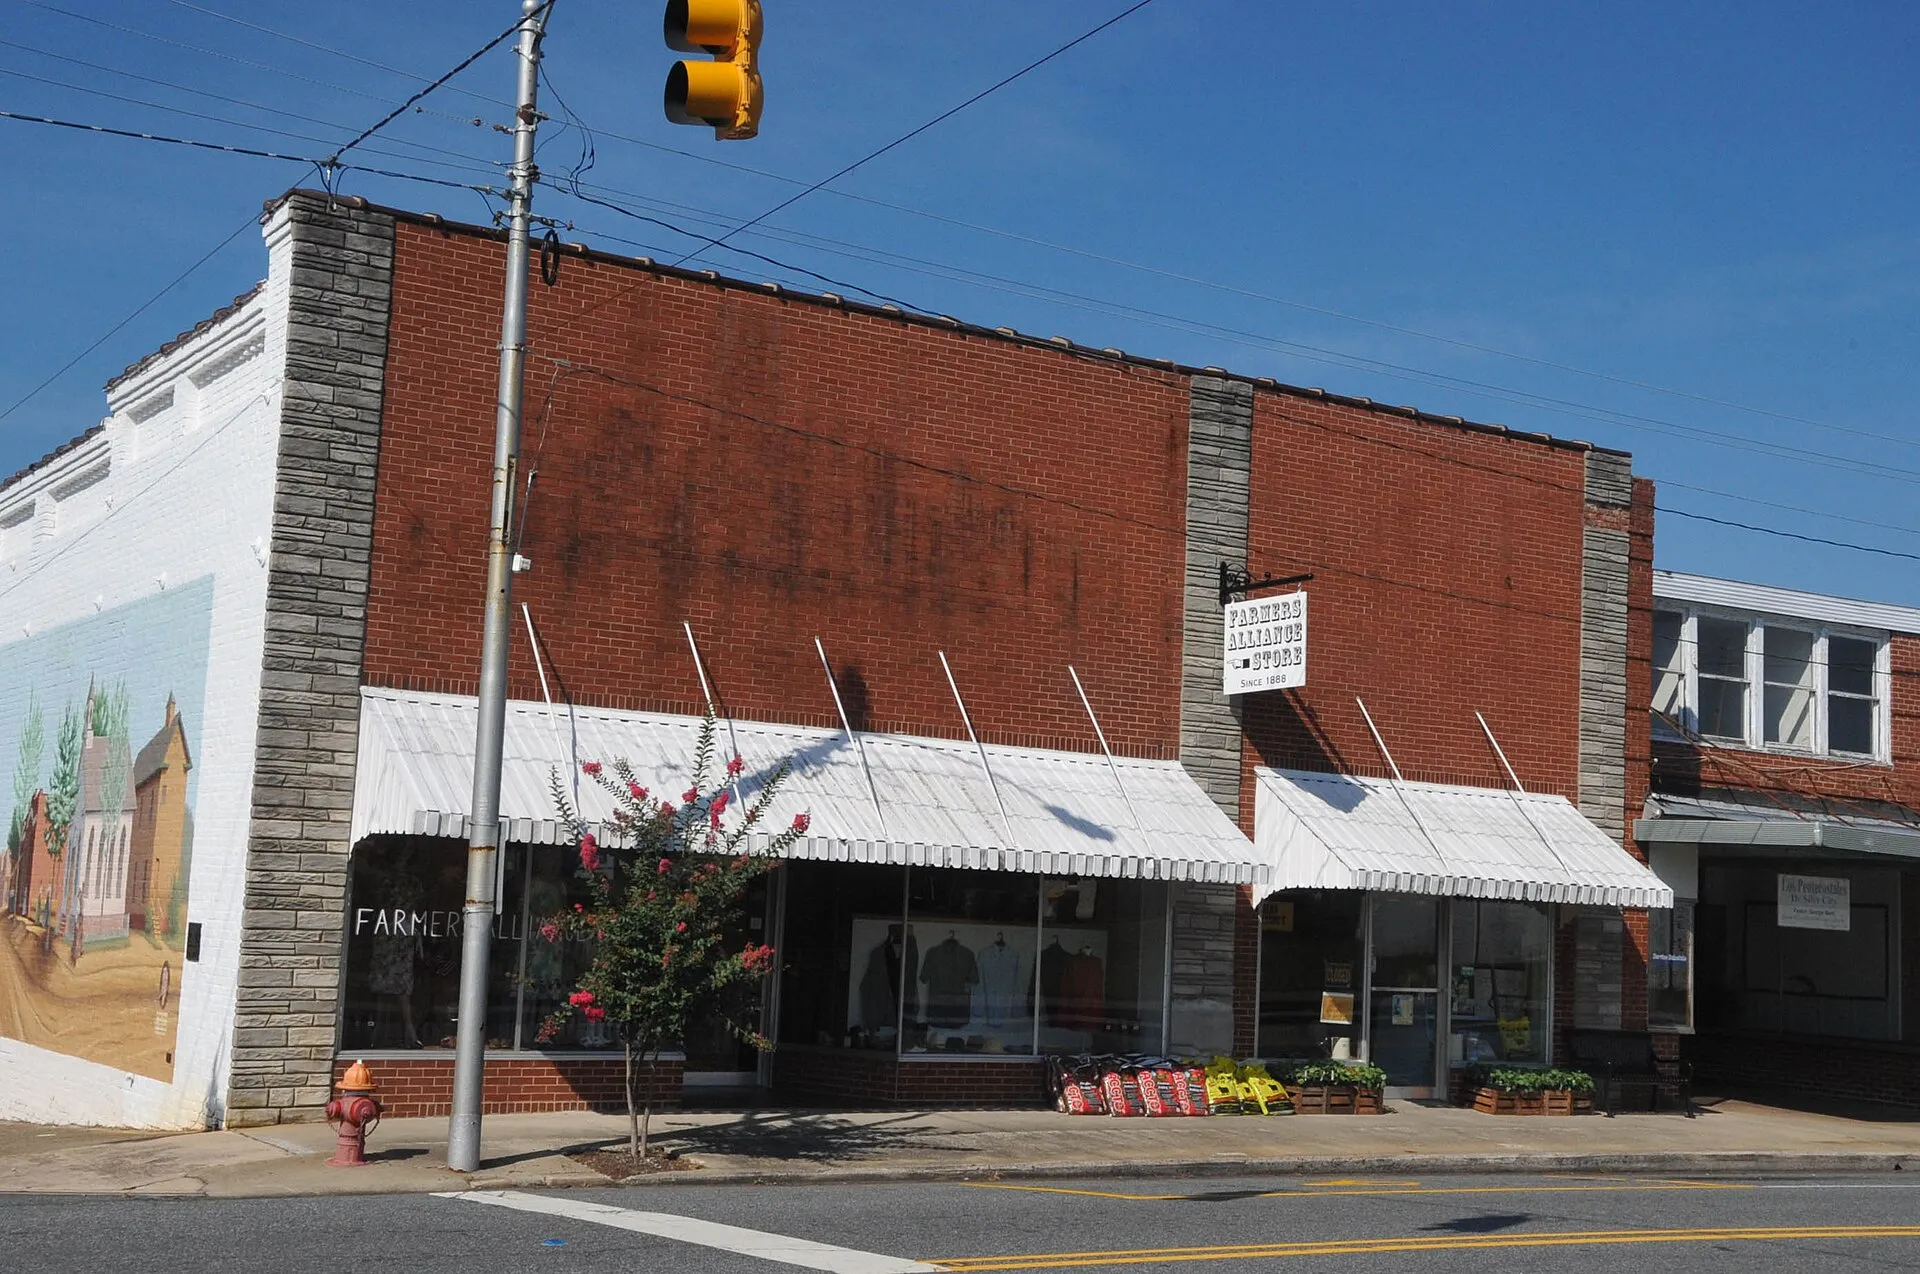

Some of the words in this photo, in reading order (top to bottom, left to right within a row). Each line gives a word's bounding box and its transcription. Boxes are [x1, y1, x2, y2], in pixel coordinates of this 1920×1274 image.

[1229, 600, 1302, 628] FARMERS
[1228, 623, 1303, 651] ALLIANCE
[1252, 647, 1302, 671] STORE
[1240, 678, 1262, 688] SINCE
[1266, 674, 1287, 685] 1888
[355, 908, 464, 938] FARMER
